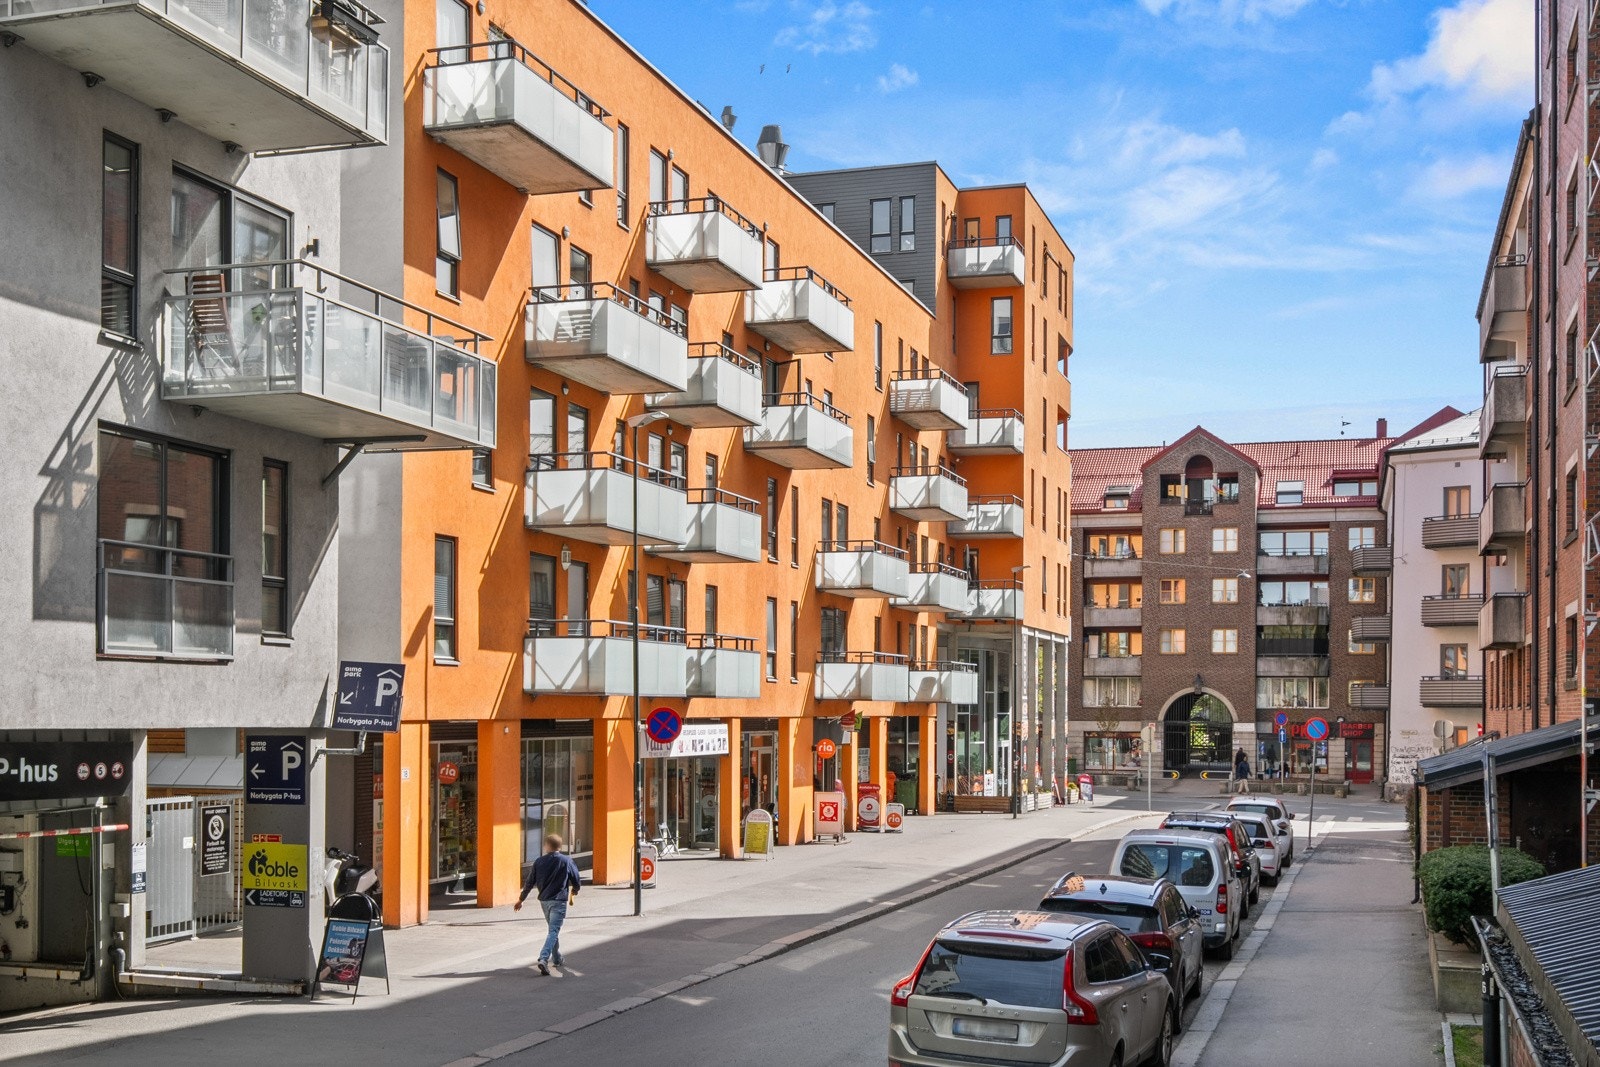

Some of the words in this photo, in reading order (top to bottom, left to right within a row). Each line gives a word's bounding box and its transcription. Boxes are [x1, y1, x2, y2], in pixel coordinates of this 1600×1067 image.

[375, 677, 399, 707] P
[337, 716, 372, 726] Norbygata
[374, 718, 393, 726] P-hus
[818, 742, 832, 752] ria
[282, 750, 302, 780] P
[440, 764, 456, 777] ria
[250, 792, 282, 800] Norbygata
[888, 814, 900, 823] ria
[251, 857, 298, 878] boble
[256, 878, 298, 888] Bilvask
